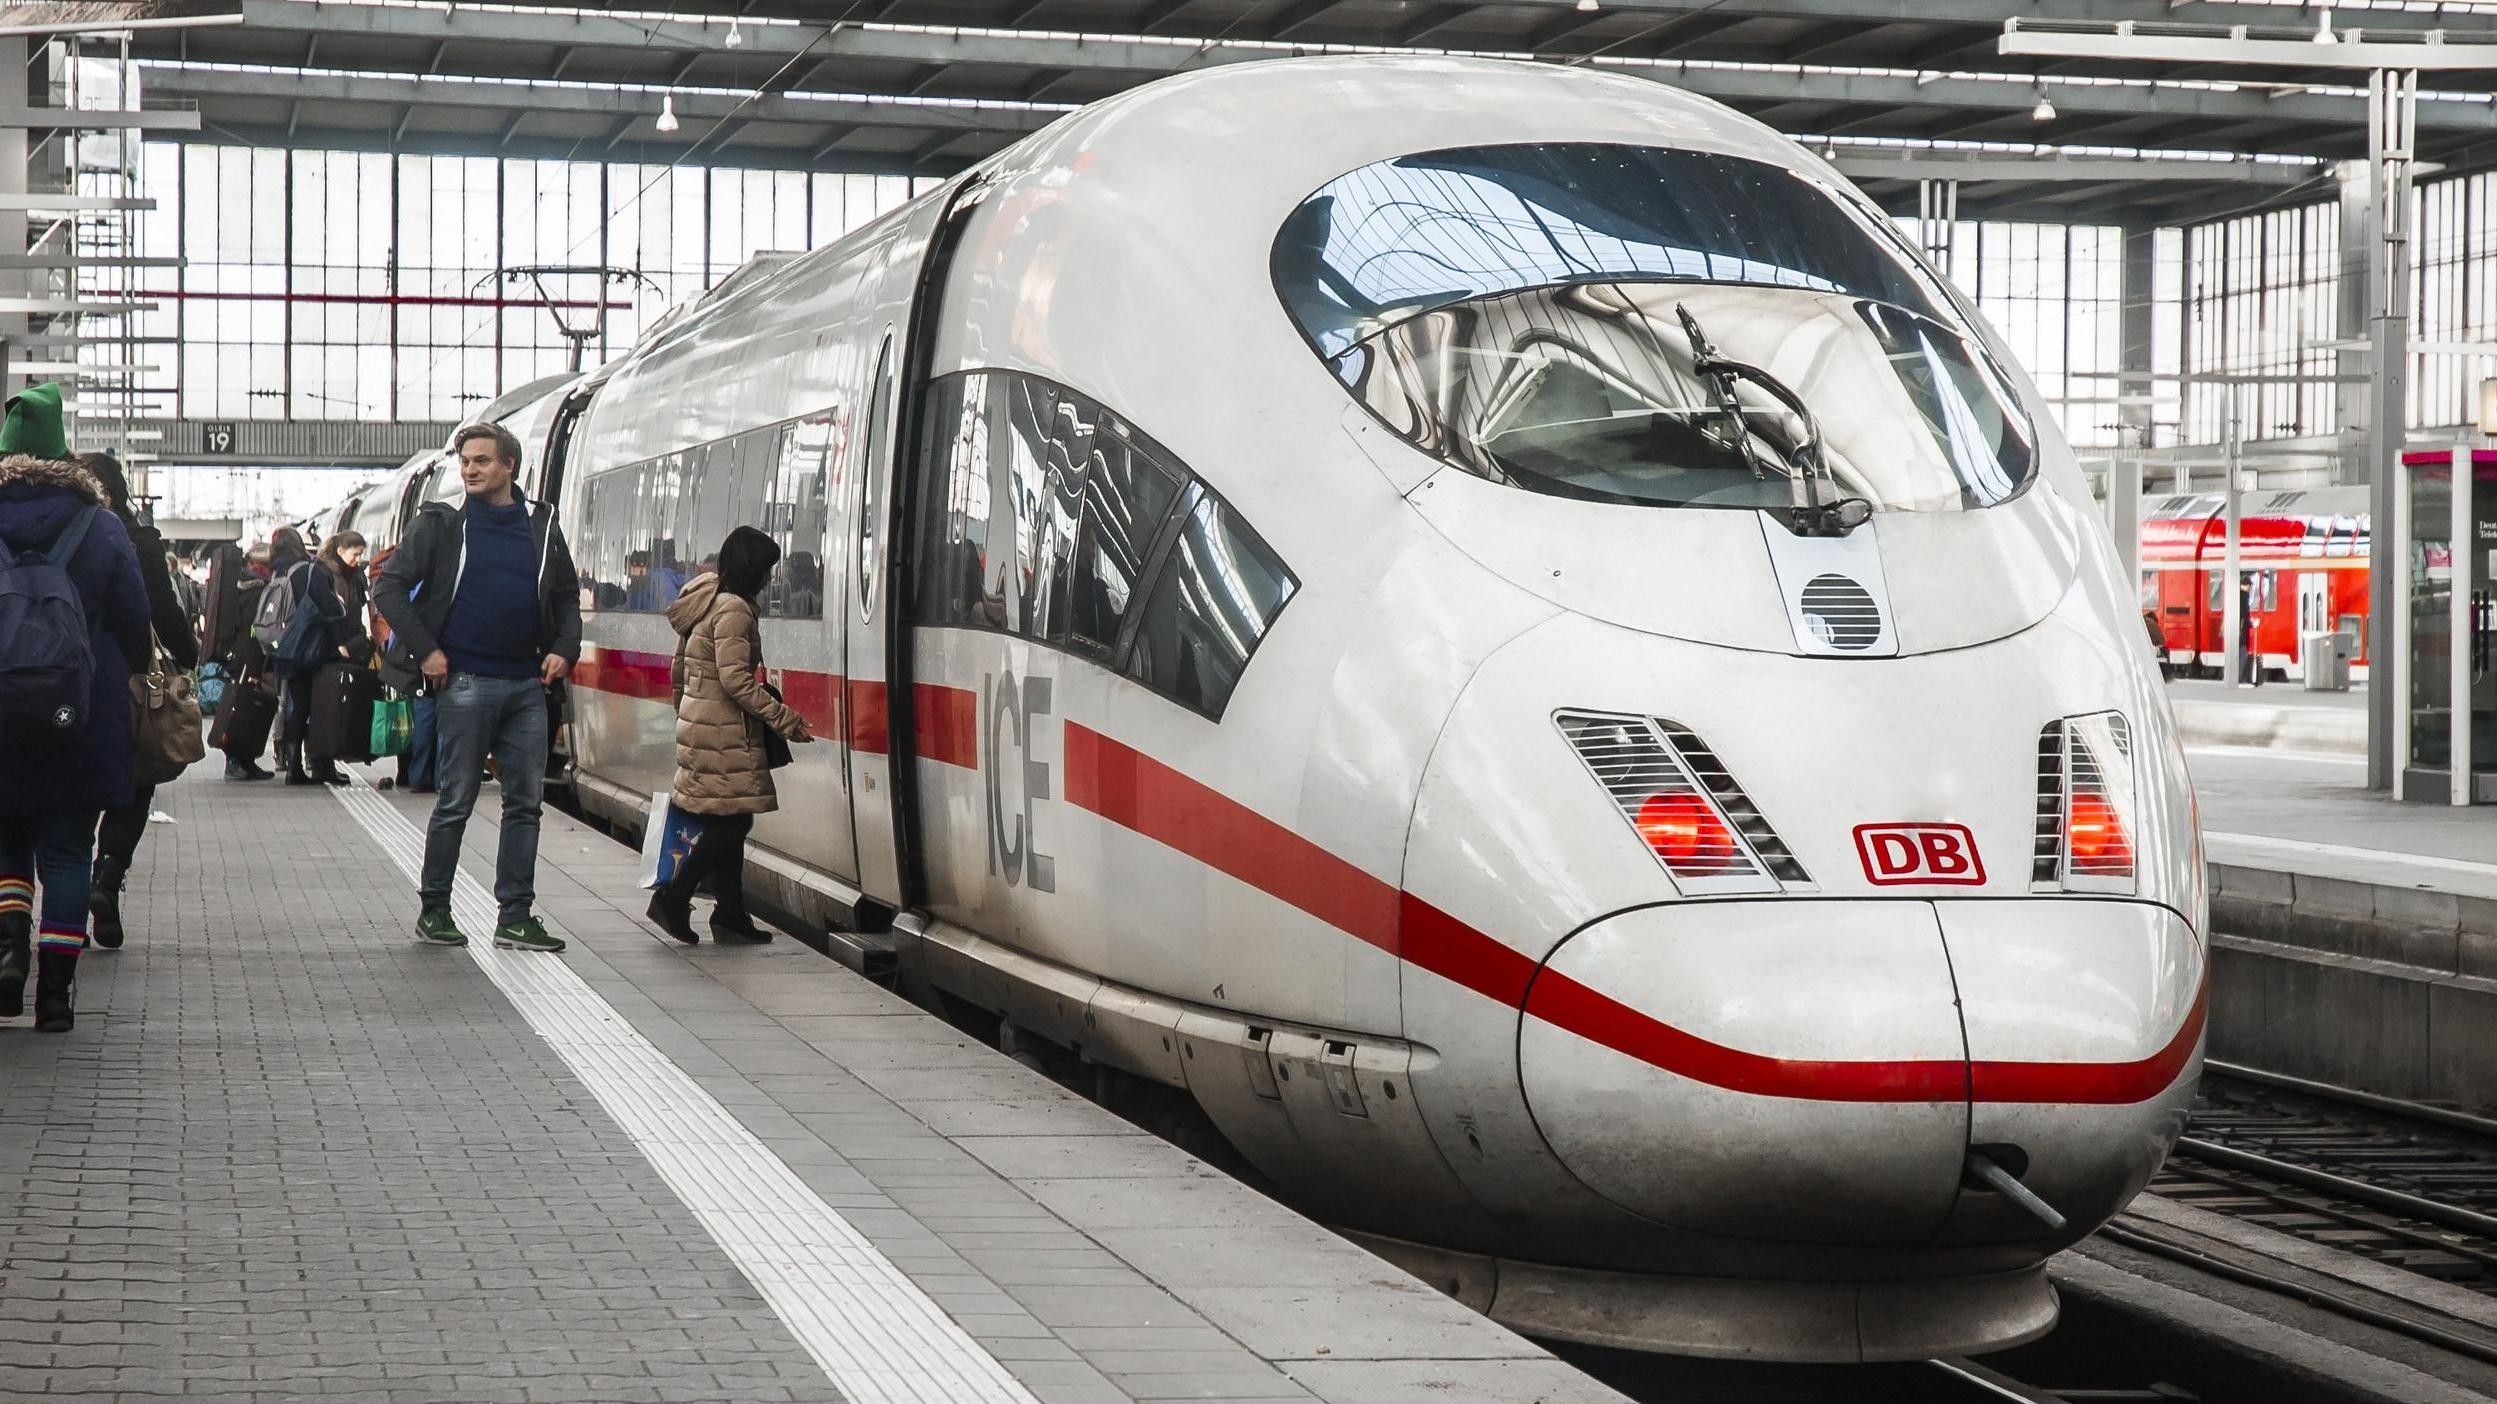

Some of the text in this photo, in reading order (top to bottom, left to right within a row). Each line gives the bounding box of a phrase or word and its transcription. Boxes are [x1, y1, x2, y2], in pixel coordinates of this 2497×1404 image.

[208, 432, 230, 452] 19
[984, 669, 1055, 894] ICE
[1869, 832, 1969, 875] DB
